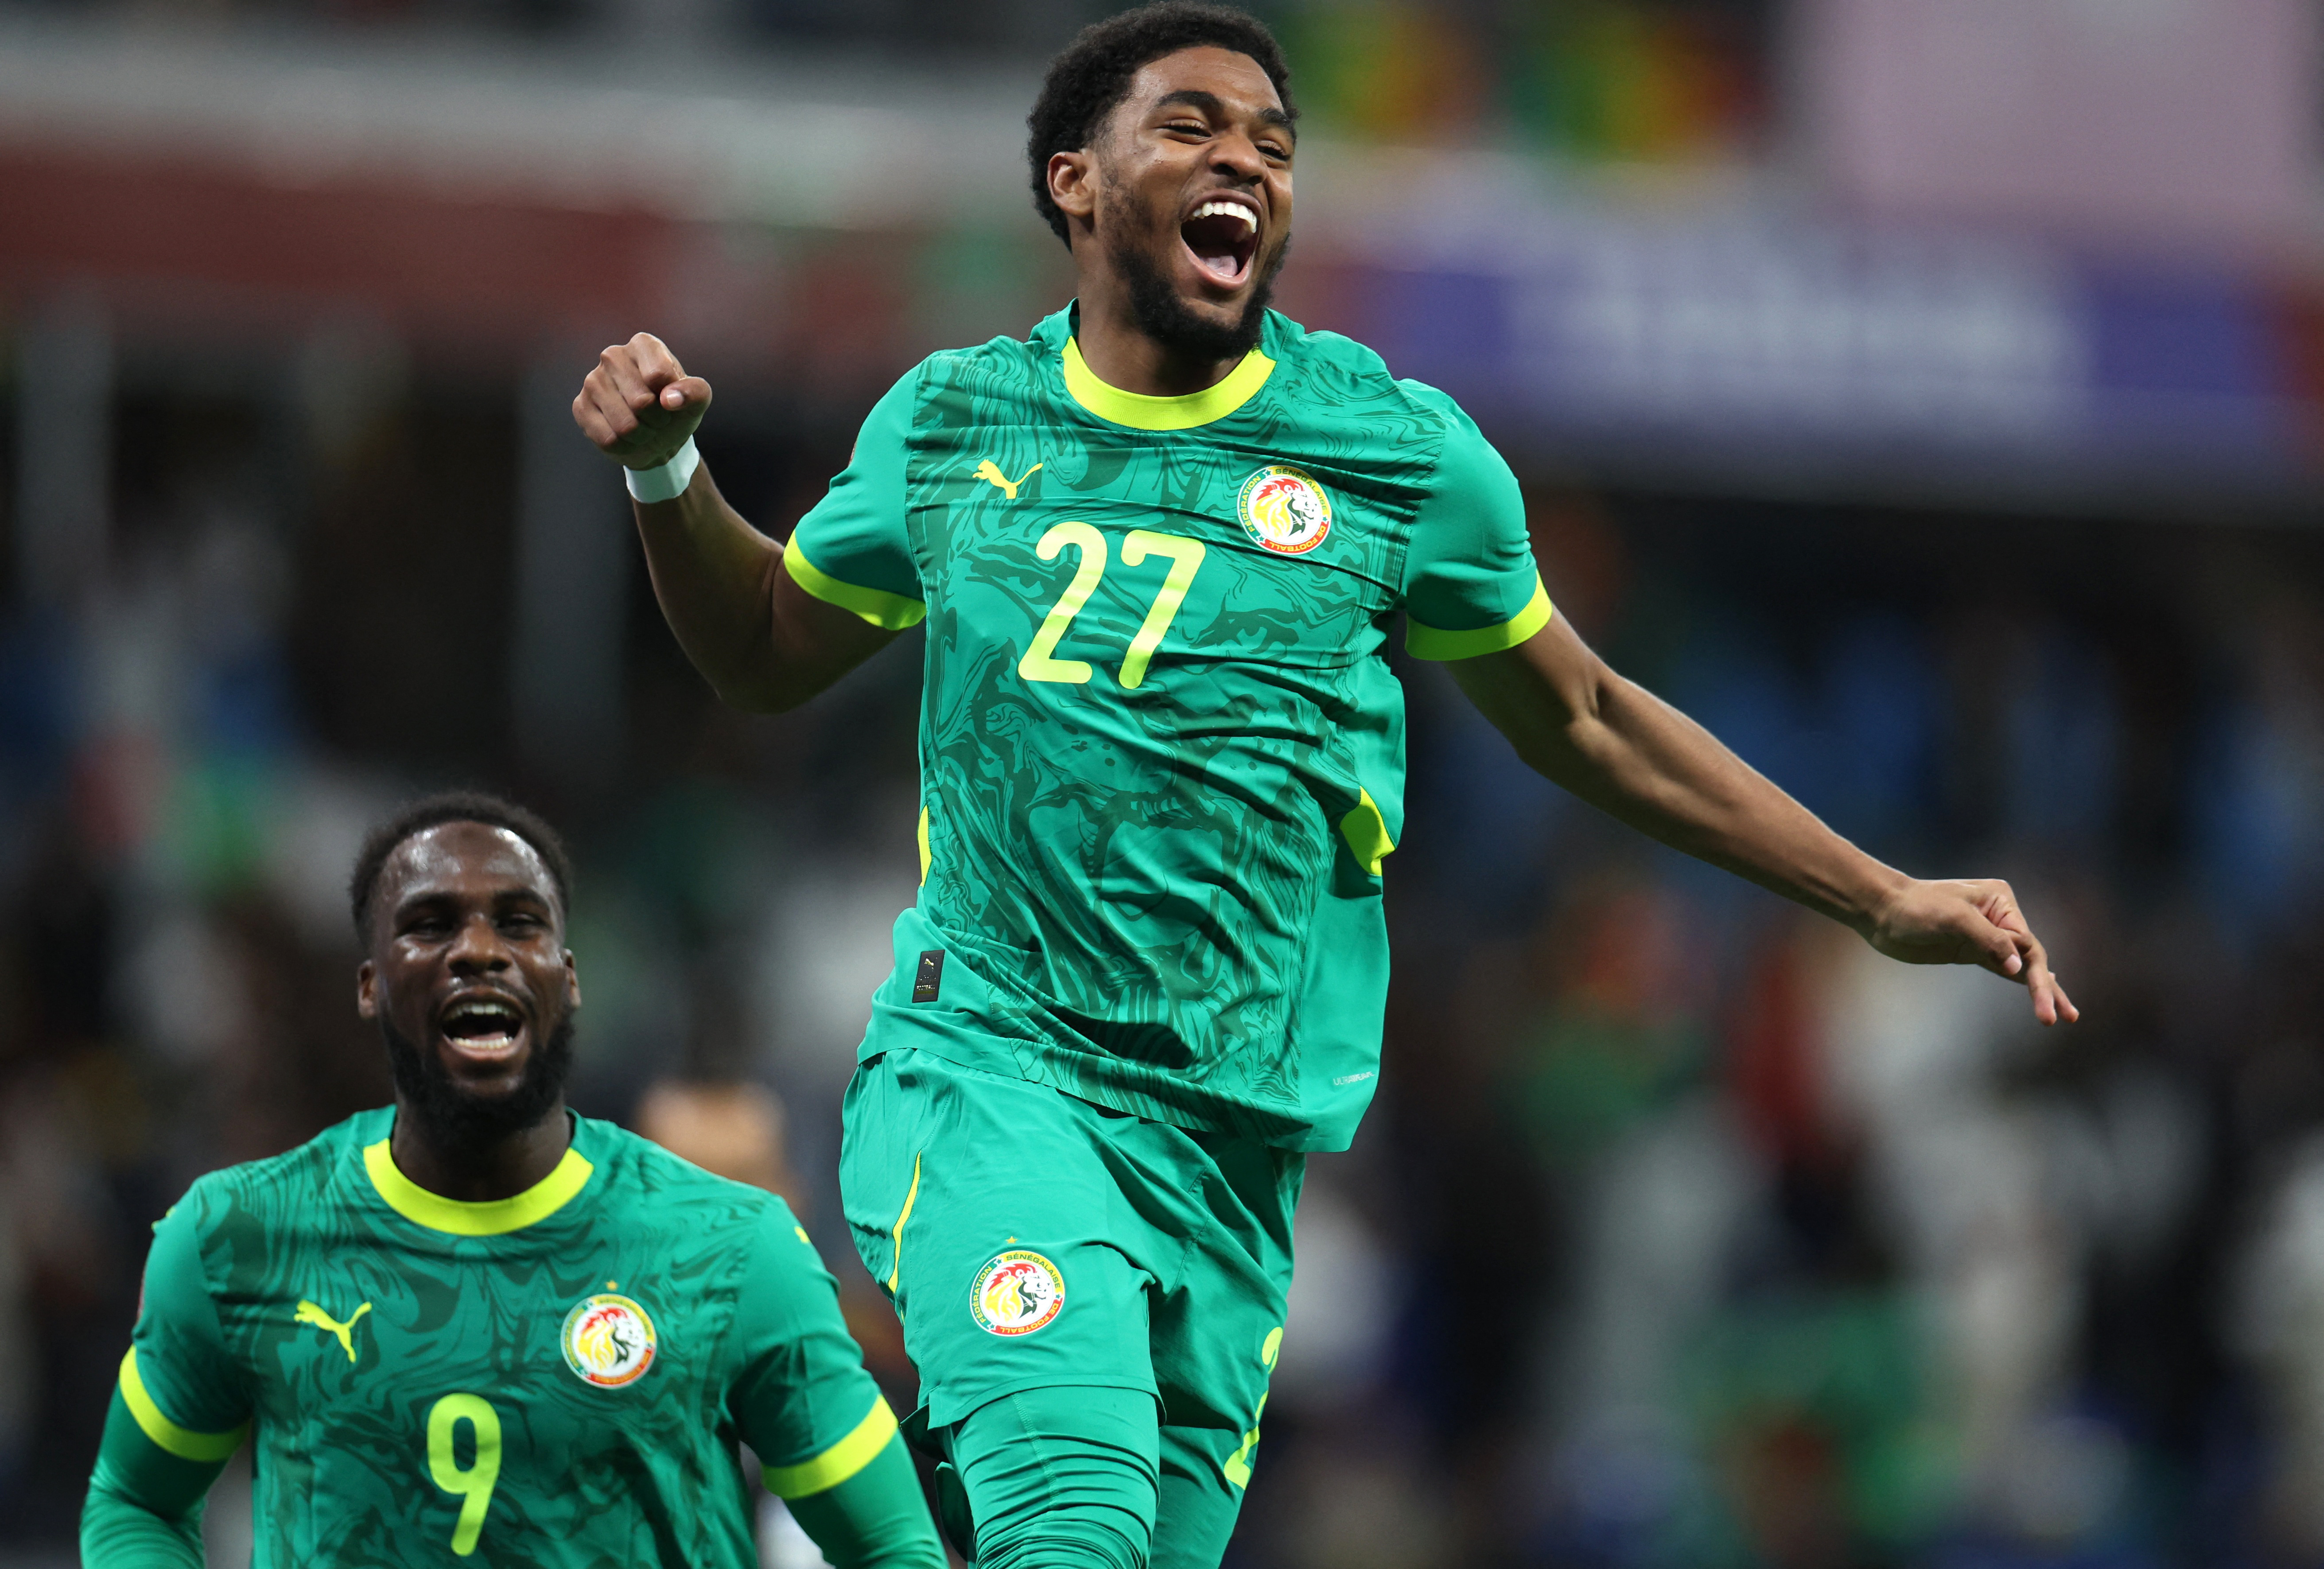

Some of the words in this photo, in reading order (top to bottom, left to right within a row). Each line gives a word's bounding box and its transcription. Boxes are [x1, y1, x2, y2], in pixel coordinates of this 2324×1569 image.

[1240, 475, 1261, 532] FÉDÉRATION
[1275, 467, 1327, 510] SÉNÉGALAISE
[1269, 537, 1318, 552] FOOTBALL
[1316, 526, 1326, 538] DE
[1018, 521, 1206, 689] 27
[1006, 1253, 1061, 1289] SÉNÉGALAISE
[972, 1266, 992, 1323] FÉDÉRATION
[1049, 1303, 1059, 1316] DE
[1000, 1315, 1049, 1334] FOOTBALL
[427, 1392, 502, 1557] 9
